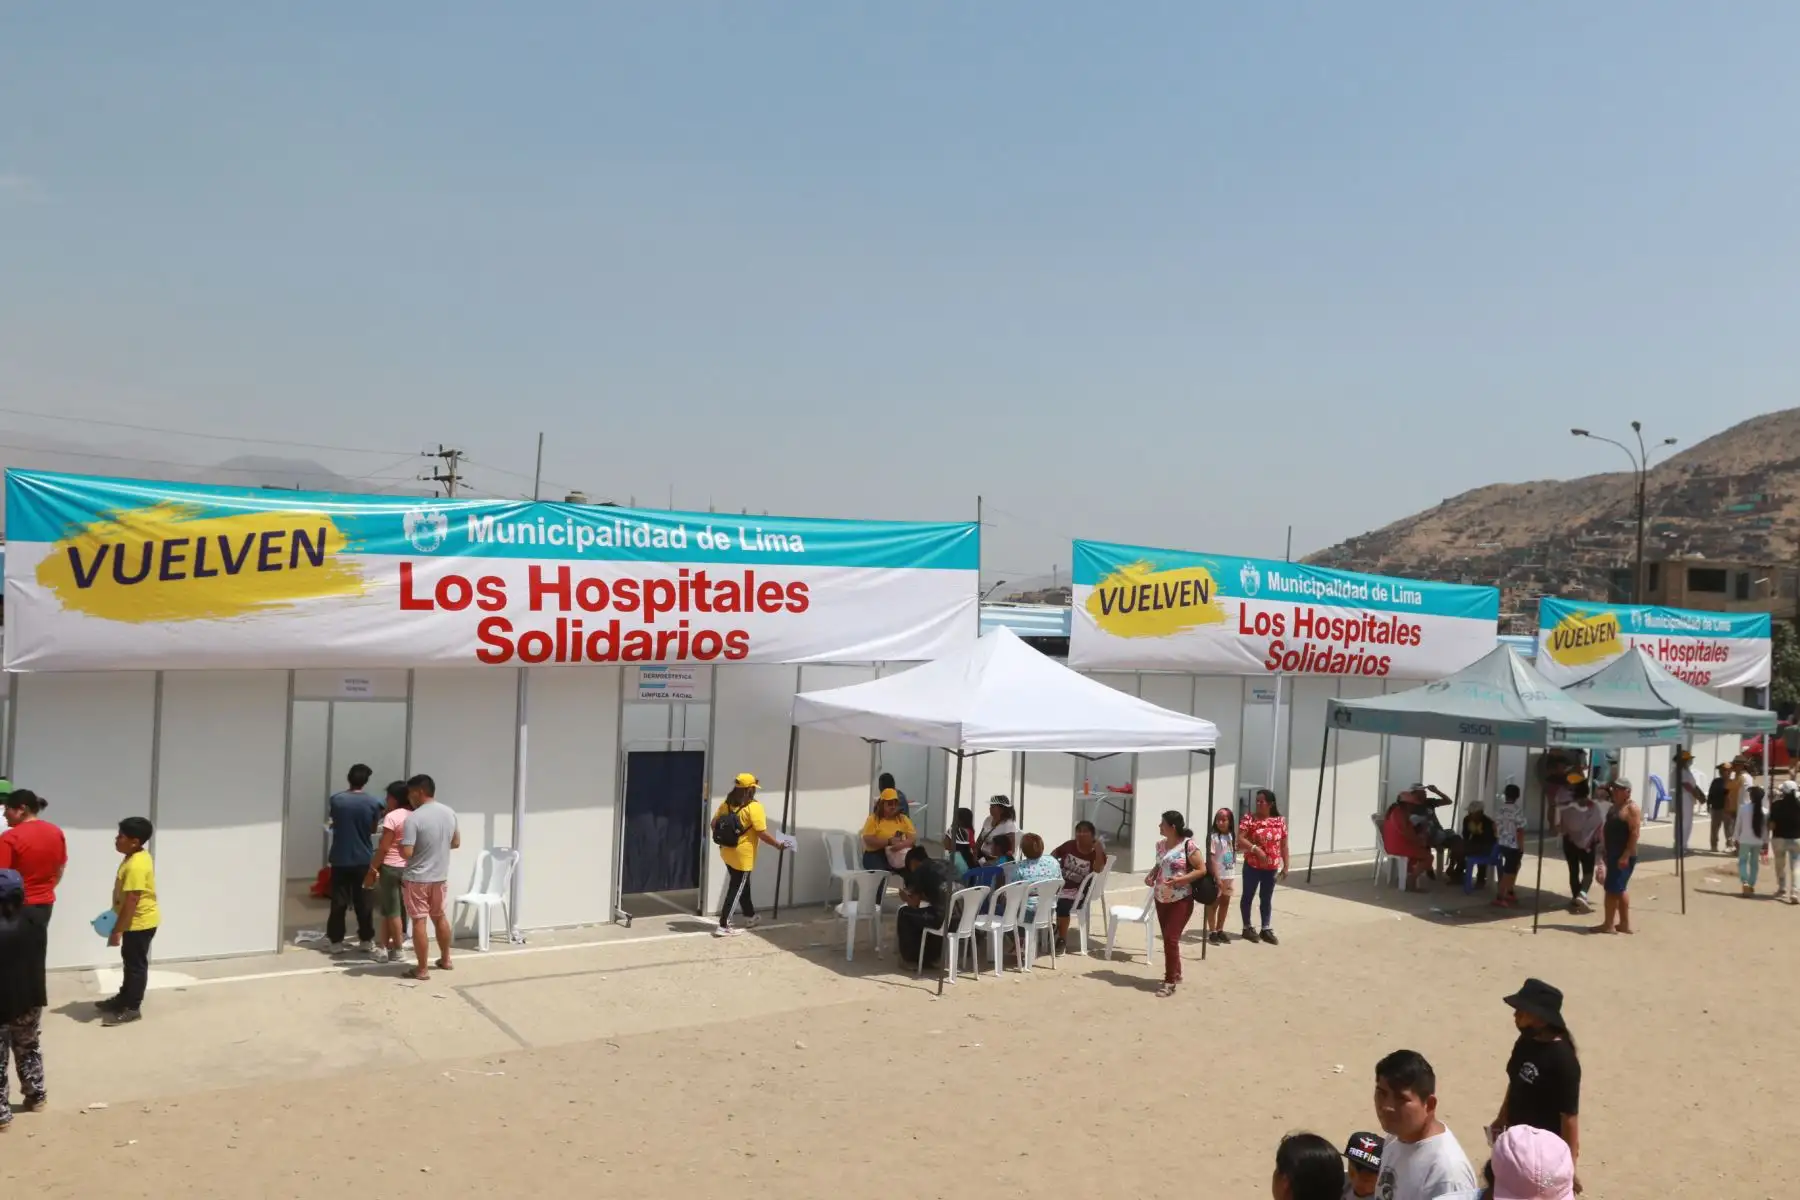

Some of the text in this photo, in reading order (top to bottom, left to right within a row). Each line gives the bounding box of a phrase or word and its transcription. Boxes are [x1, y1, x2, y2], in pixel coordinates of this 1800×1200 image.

[467, 513, 805, 553] Municipalidad de Lima
[68, 526, 327, 589] VUELVEN
[399, 561, 810, 622] Los Hospitales
[1099, 578, 1210, 616] VUELVEN
[1267, 571, 1422, 605] Municipalidad de Lima
[476, 616, 749, 664] Solidarios
[1239, 602, 1422, 650] Los Hospitales
[1553, 621, 1617, 650] VUELVEN
[1264, 640, 1391, 677] Solidarios
[1658, 638, 1730, 667] Hospitales
[1459, 723, 1495, 736] SISOL
[1348, 1147, 1381, 1165] FREE FIRE
